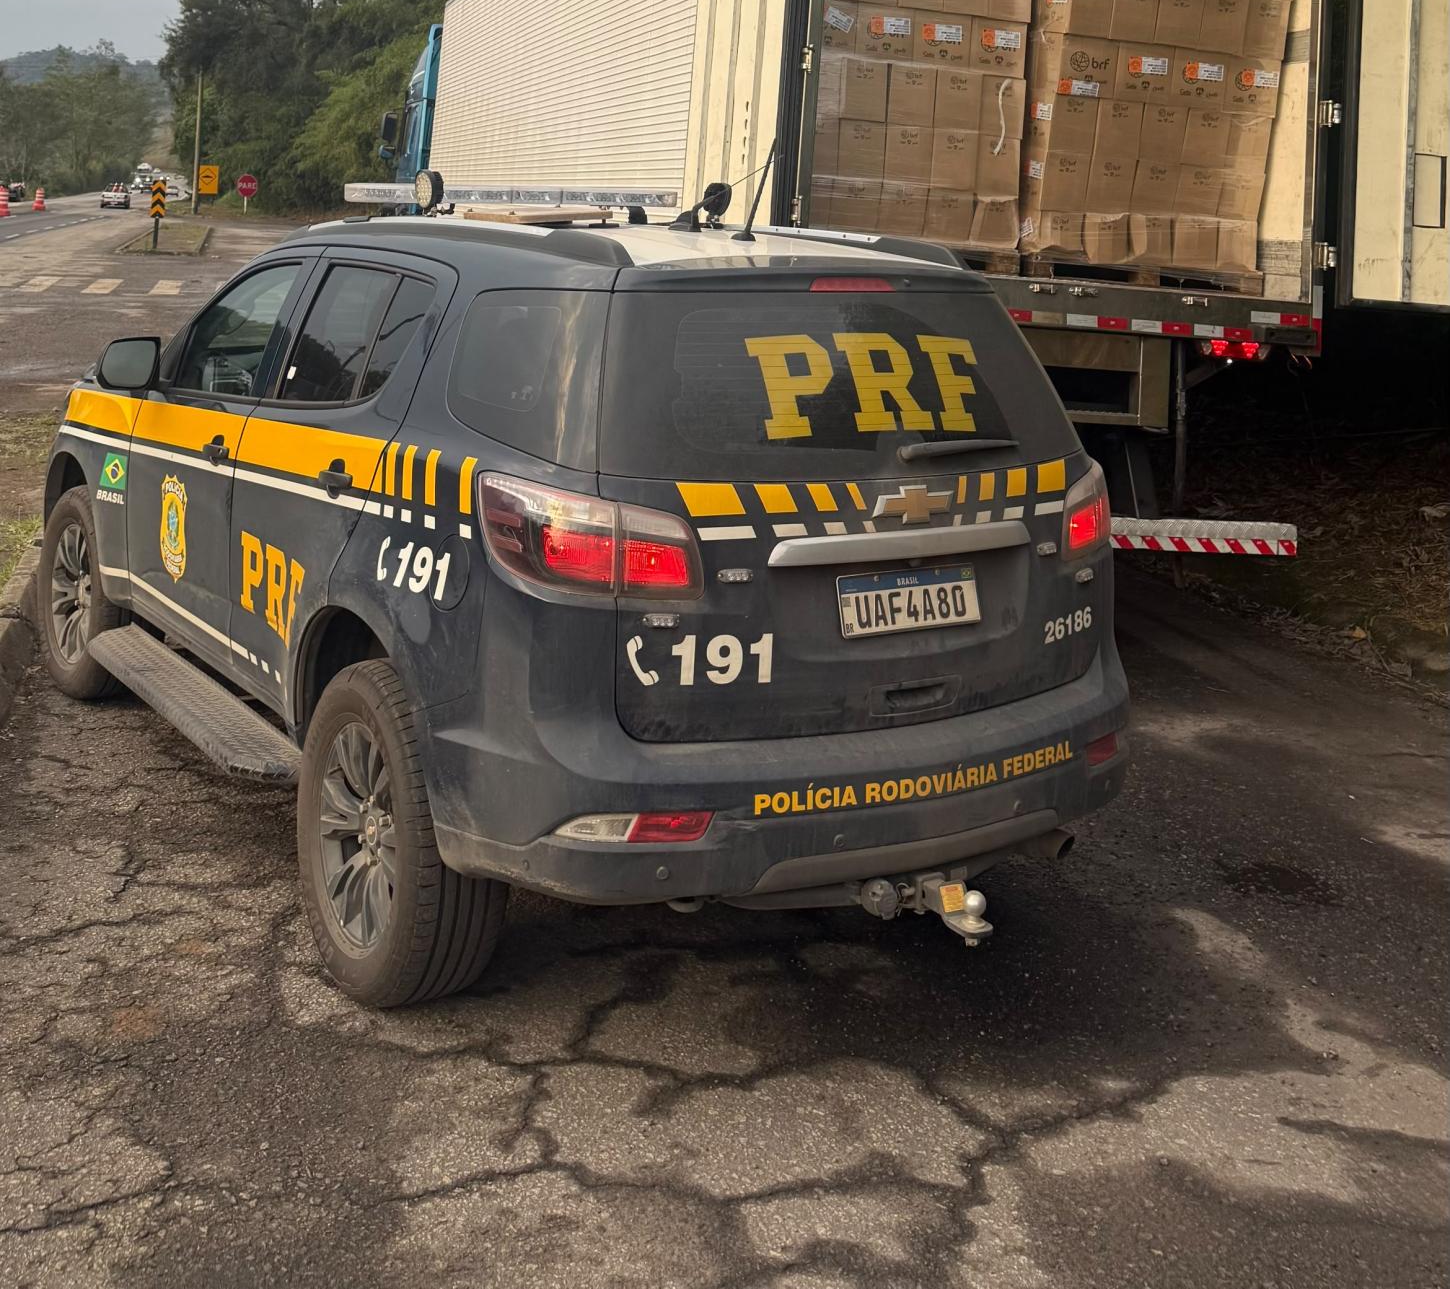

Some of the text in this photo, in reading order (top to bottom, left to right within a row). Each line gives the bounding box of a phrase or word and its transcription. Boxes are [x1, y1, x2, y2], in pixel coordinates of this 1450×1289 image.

[1091, 57, 1111, 71] brf
[239, 182, 257, 190] PARE
[744, 332, 978, 440] PRF
[96, 489, 125, 505] BRASIL
[240, 530, 306, 649] PRF
[393, 541, 451, 601] 191
[896, 576, 920, 586] BRASIL
[845, 622, 855, 634] BR
[855, 585, 967, 629] UAF4A80
[1043, 606, 1093, 646] 26186
[671, 632, 774, 686] 191
[753, 740, 1074, 816] POLÍCIA RODOVIÁRIA FEDERAL
